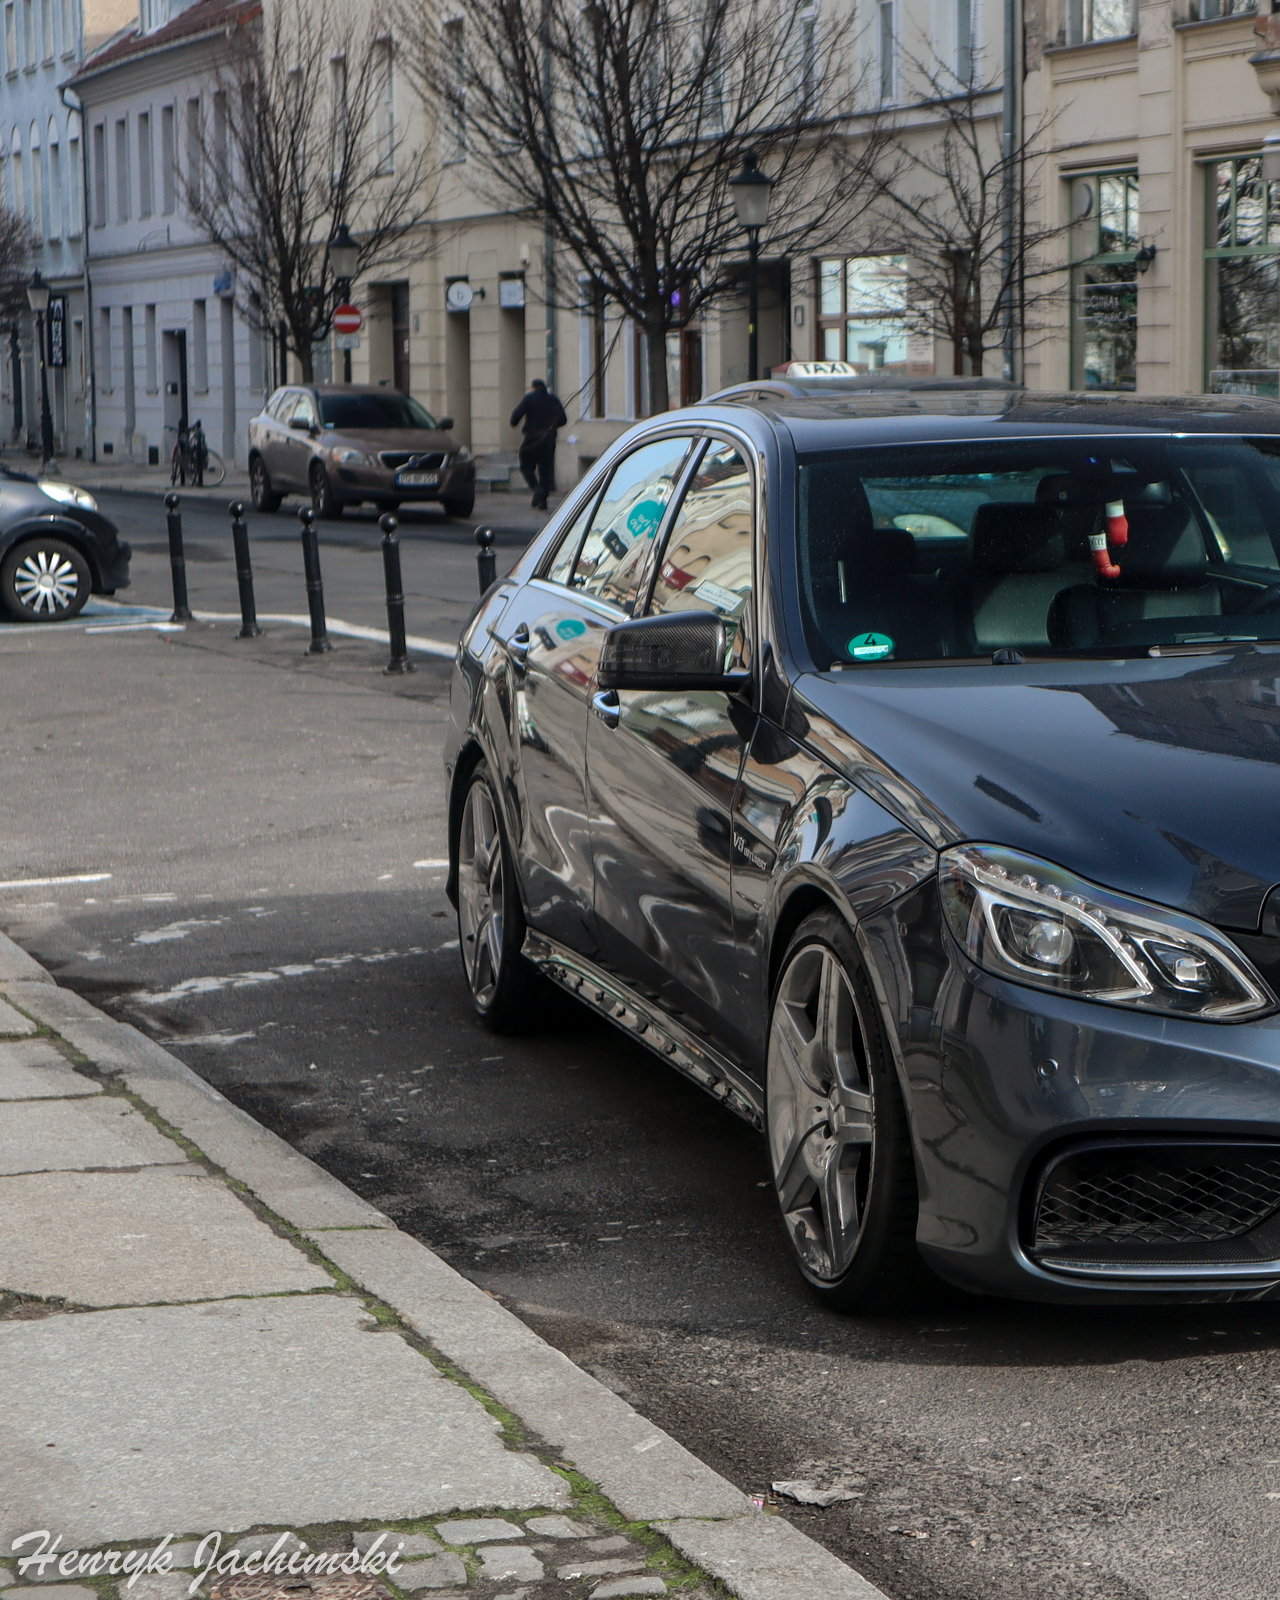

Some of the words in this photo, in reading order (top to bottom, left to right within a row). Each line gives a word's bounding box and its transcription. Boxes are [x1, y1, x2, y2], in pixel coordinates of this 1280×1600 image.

[797, 363, 848, 374] TAXI
[864, 633, 877, 646] 4
[733, 831, 745, 853] V8
